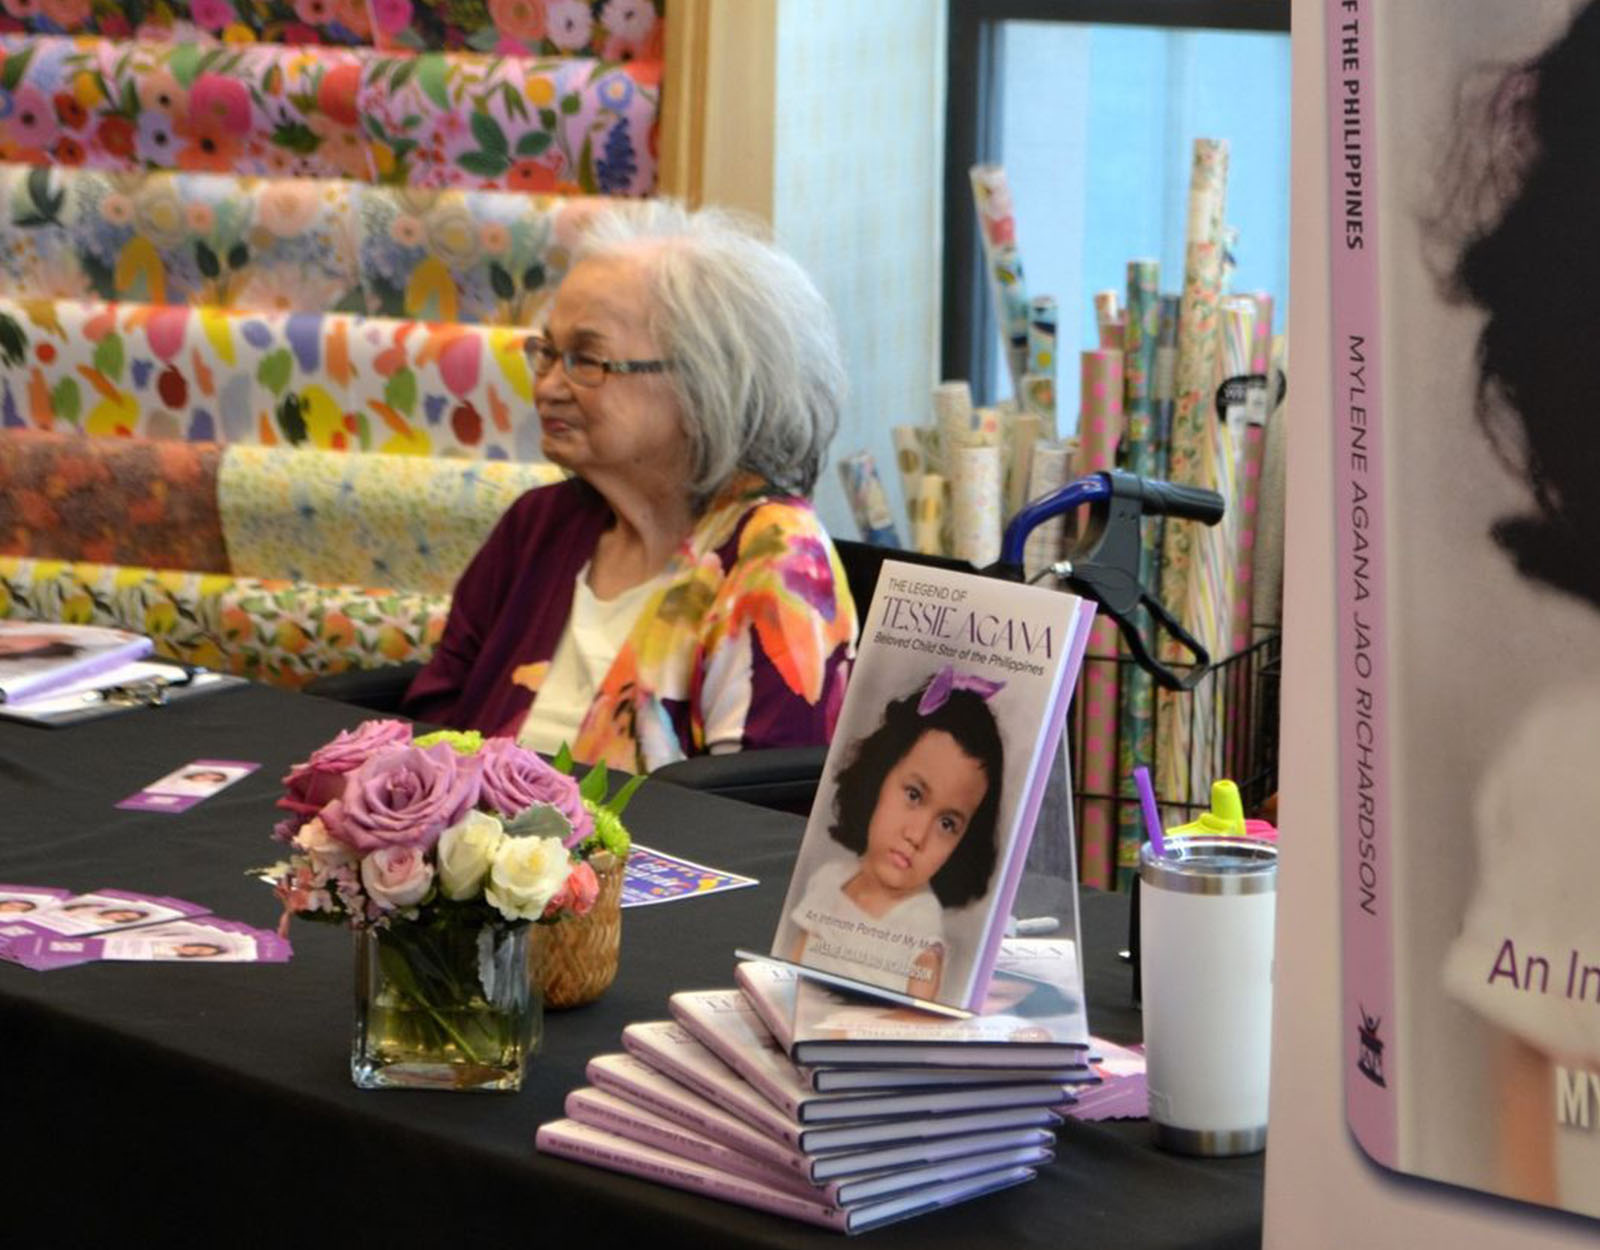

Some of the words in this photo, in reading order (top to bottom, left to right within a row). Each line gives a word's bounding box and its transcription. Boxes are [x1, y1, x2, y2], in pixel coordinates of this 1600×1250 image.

[1341, 19, 1360, 71] THE
[1344, 79, 1364, 250] PHILIPPINES
[1349, 335, 1368, 472] MYLENE
[1351, 481, 1370, 602] AGANA
[888, 578, 907, 593] THE
[907, 582, 950, 600] LEGEND
[951, 589, 968, 602] OF
[874, 631, 911, 649] Beloved
[911, 638, 937, 654] Child
[936, 643, 958, 657] Star
[958, 649, 971, 660] of
[970, 650, 987, 665] the
[987, 654, 1045, 676] Philippines
[881, 595, 958, 637] TESSIE
[956, 611, 1052, 659] AGANA
[1353, 611, 1372, 679] JAO
[1356, 687, 1377, 916] RICHARDSON
[855, 922, 891, 942] Portrait
[890, 933, 903, 943] of
[1487, 939, 1550, 994] An
